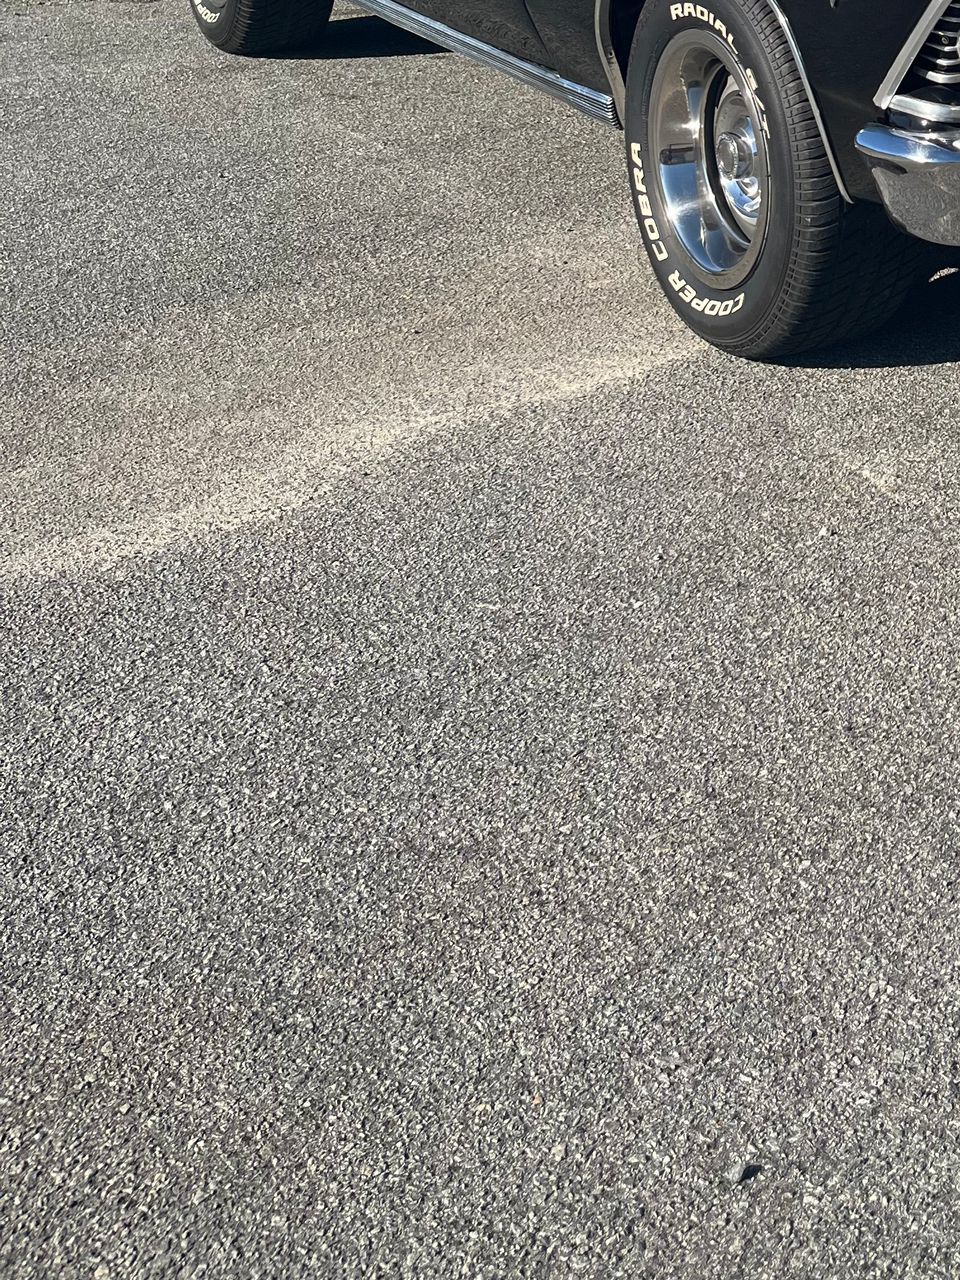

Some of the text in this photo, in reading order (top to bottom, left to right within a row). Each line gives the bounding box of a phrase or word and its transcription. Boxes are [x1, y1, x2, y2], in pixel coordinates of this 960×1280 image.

[670, 2, 739, 55] RADIAL
[631, 142, 745, 317] COOPER COBRA
